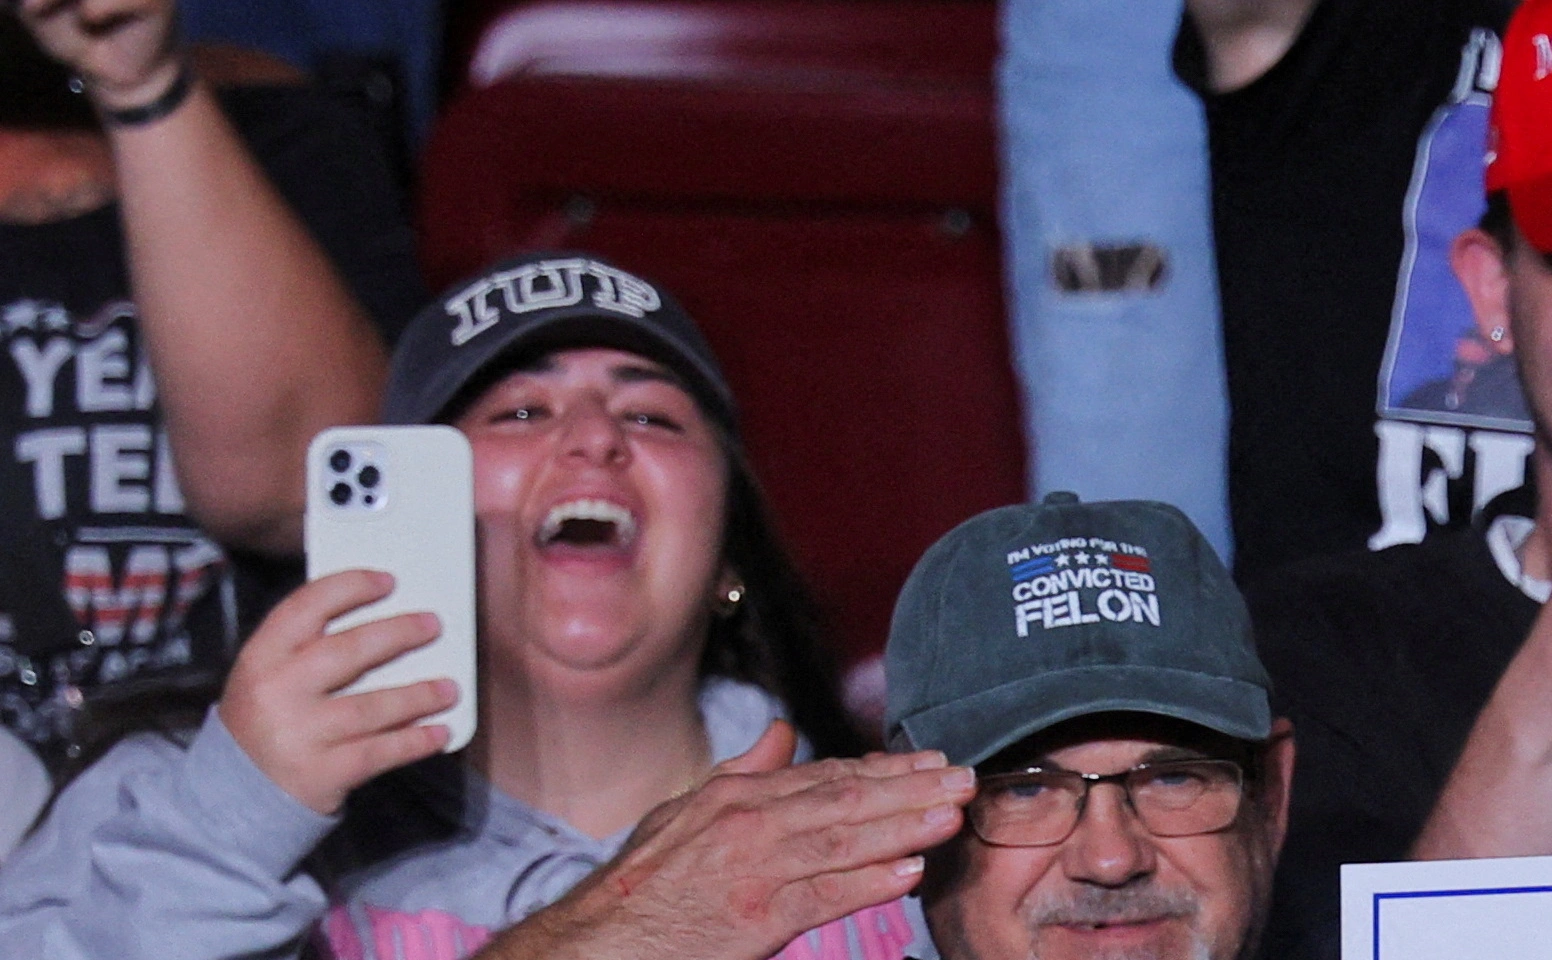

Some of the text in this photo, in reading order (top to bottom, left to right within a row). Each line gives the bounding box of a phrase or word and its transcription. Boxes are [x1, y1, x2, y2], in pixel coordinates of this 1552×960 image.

[444, 257, 661, 346] IUP
[1031, 537, 1087, 554] VOTING
[1012, 567, 1155, 602] CONVICTED
[1014, 588, 1161, 638] FELON
